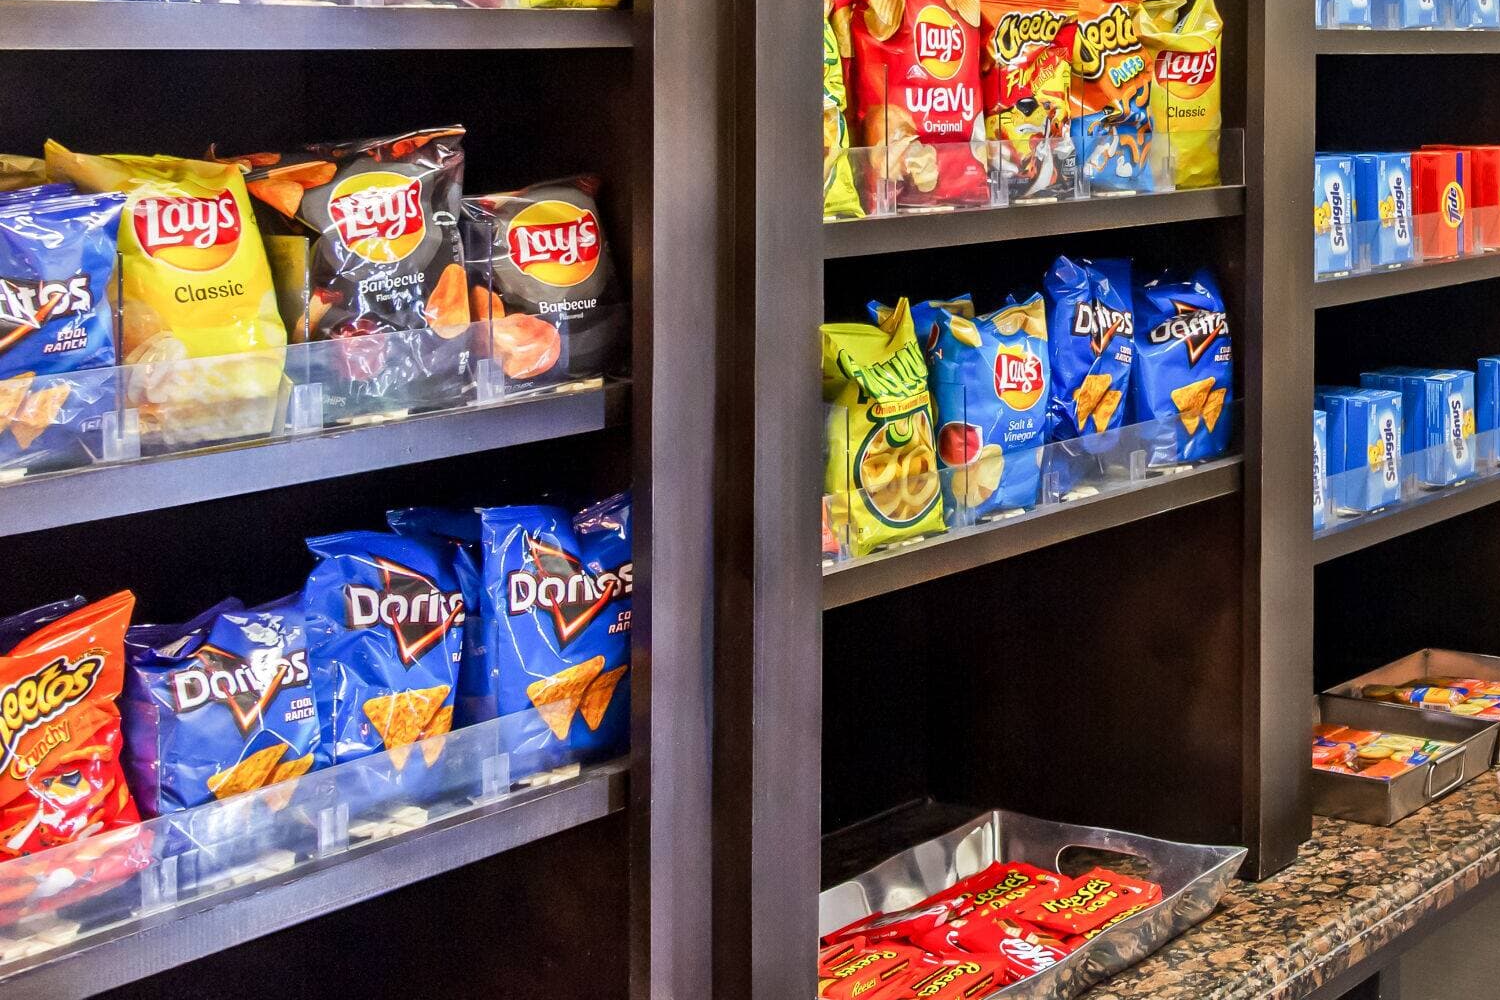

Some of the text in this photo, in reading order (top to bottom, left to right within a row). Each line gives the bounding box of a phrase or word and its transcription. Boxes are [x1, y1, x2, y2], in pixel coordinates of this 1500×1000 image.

[919, 22, 963, 63] Lay's
[995, 10, 1063, 60] Cheeto
[1109, 54, 1145, 87] Puffs
[1158, 49, 1216, 85] Lay's
[905, 82, 975, 121] wavy
[1167, 105, 1207, 119] Classic
[924, 119, 963, 137] Original
[144, 196, 236, 249] Lay's
[1330, 182, 1344, 248] Snuggle
[1394, 176, 1408, 240] Snuggle
[1447, 186, 1464, 225] Tide
[515, 216, 597, 265] Lay's
[173, 279, 245, 304] Classic
[358, 271, 426, 296] Barbecue
[538, 296, 598, 315] Barbecue
[1150, 311, 1229, 344] Dorito
[43, 338, 87, 354] RANCH
[1003, 430, 1038, 443] Vinegar
[1008, 420, 1025, 431] Salt
[1451, 399, 1463, 461] Snuggle
[1382, 418, 1396, 483] Snuggle
[345, 584, 466, 627] Dorito
[617, 611, 632, 623] CO
[608, 624, 632, 635] RAN
[173, 651, 309, 711] Dorios
[285, 708, 316, 723] RANCH
[290, 697, 313, 711] COOL
[12, 719, 71, 780] Crunchy
[972, 871, 1030, 905] eese's
[1041, 877, 1113, 914] Reese's
[833, 950, 899, 978] Reese's
[916, 961, 982, 998] Reese's
